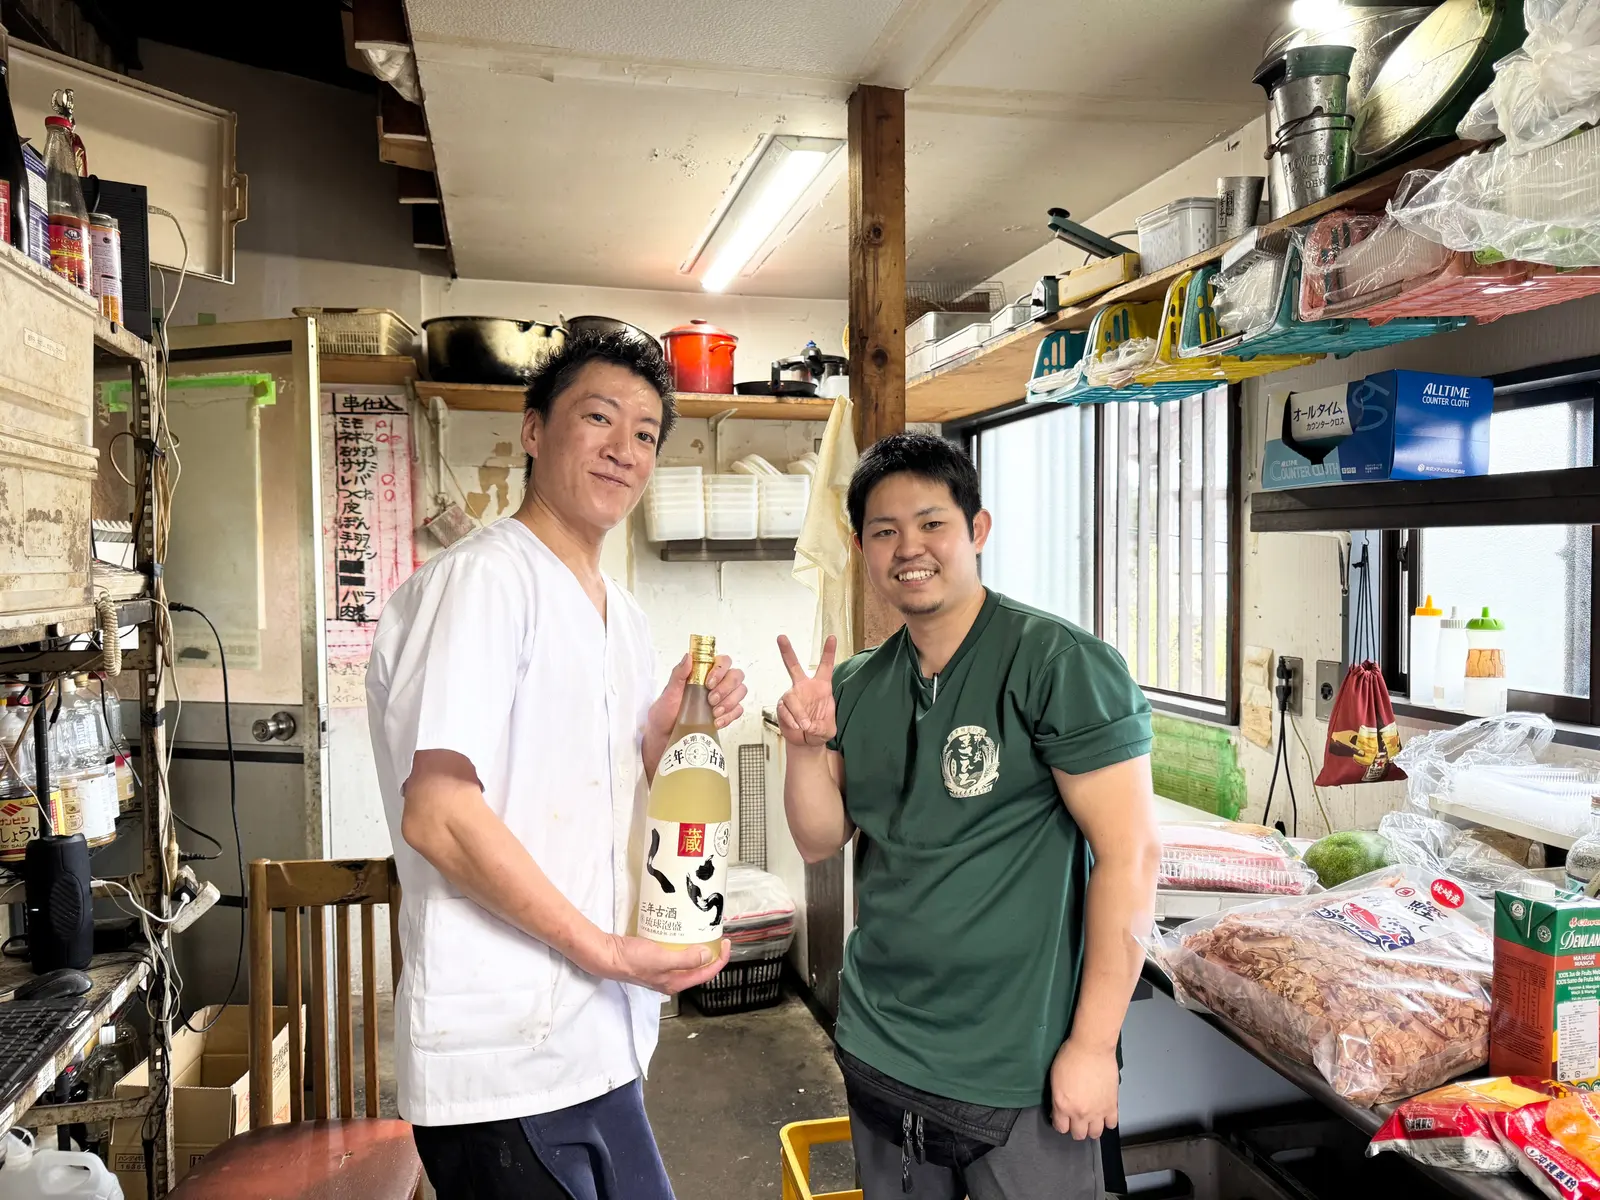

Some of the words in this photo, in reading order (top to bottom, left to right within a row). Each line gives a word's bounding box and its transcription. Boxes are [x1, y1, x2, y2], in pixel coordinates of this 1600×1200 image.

[1423, 383, 1470, 399] ALLTIME
[342, 394, 404, 413] 串仕込
[1422, 395, 1449, 406] COUNTER
[1451, 398, 1470, 408] CLOTH
[1293, 401, 1343, 422] オールタイム
[1306, 417, 1345, 431] カウンタークロス
[339, 458, 378, 473] ササミ
[341, 500, 362, 514] 皮
[342, 590, 376, 604] バラ
[663, 749, 684, 772] 三年
[709, 748, 725, 772] 古酒
[680, 828, 702, 852] 蔵
[1432, 882, 1461, 906] 枕崎産
[641, 902, 677, 919] 三年古酒
